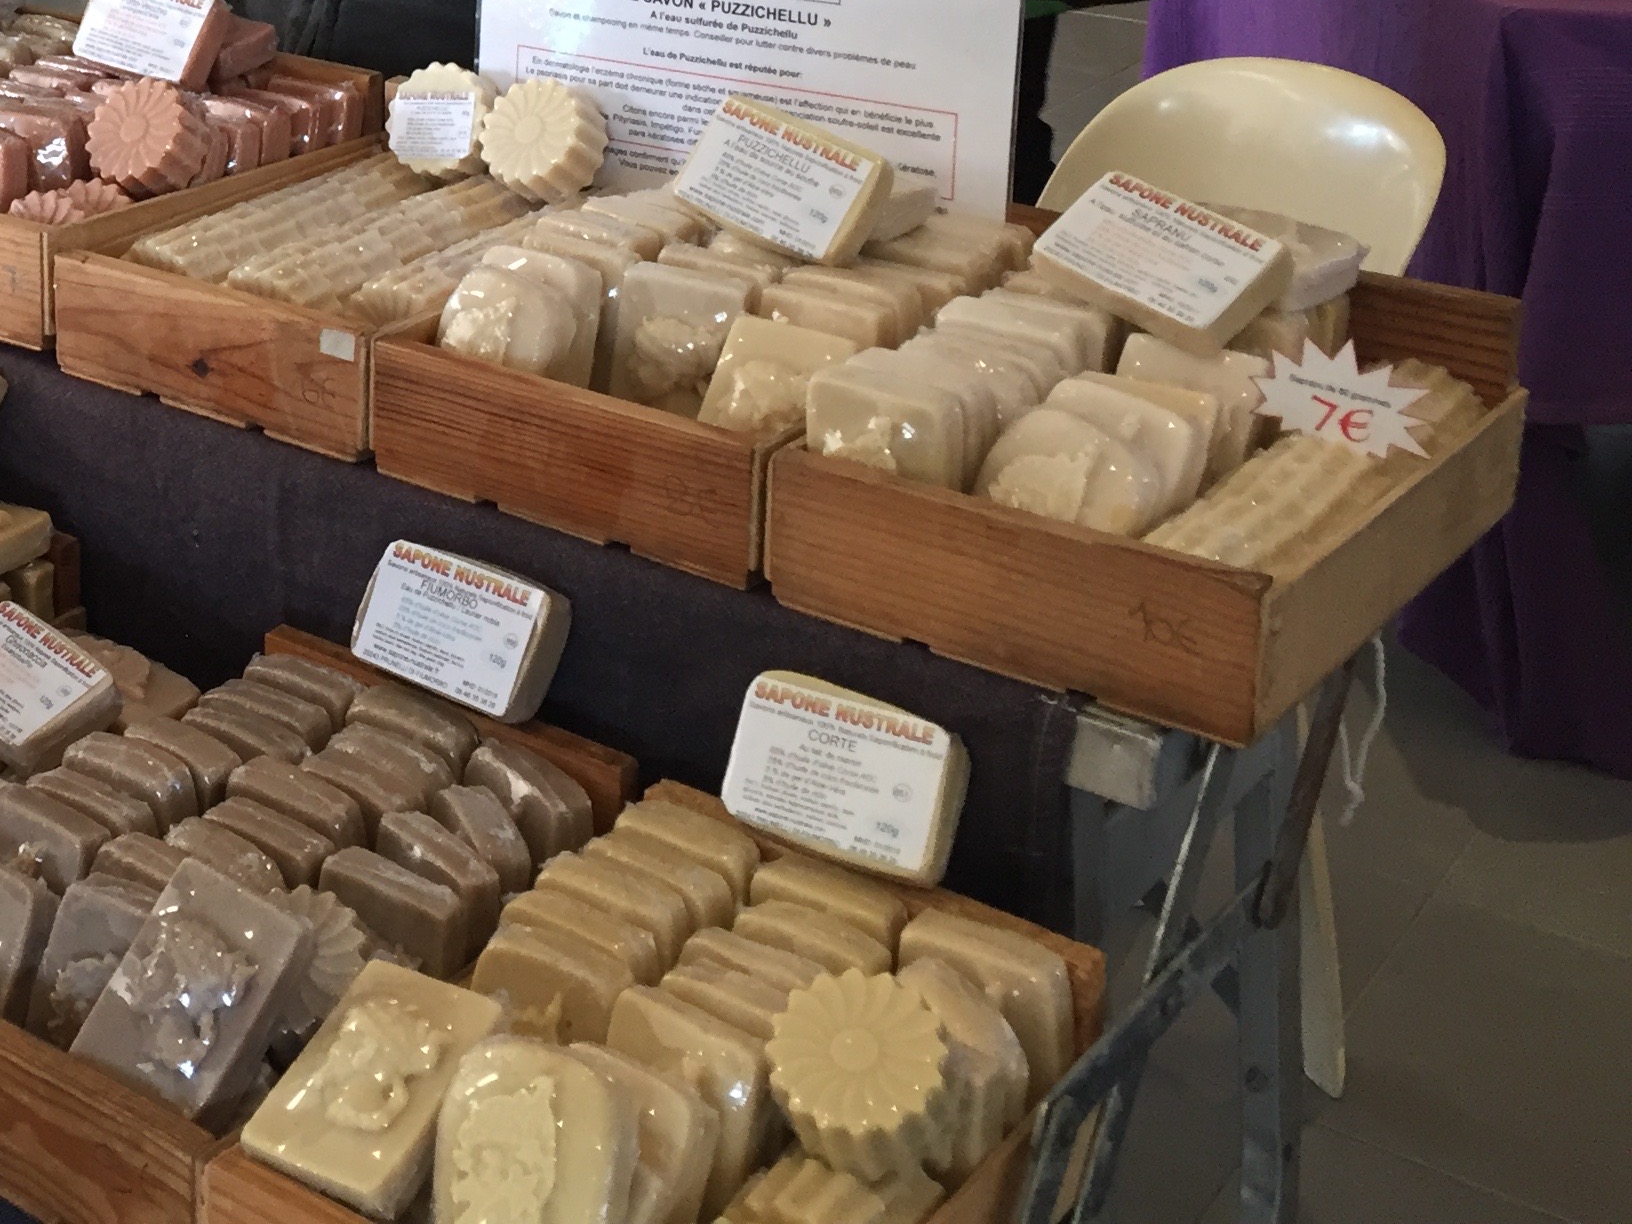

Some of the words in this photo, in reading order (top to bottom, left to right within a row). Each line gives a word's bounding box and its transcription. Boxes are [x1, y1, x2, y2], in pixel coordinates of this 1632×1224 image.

[650, 10, 658, 20] A
[659, 11, 682, 23] l'eau
[685, 14, 724, 29] sulfurée
[726, 19, 739, 31] de
[741, 22, 798, 40] Puzzichellu
[711, 0, 818, 26] PUZZICHELLU
[667, 50, 678, 60] de
[679, 52, 727, 68] Puzzichellu
[728, 61, 743, 70] est
[735, 36, 754, 47] pour
[722, 98, 781, 137] SAPONE
[781, 122, 863, 172] NUSTRALE
[737, 134, 811, 174] PUZZICHELLU
[1108, 173, 1173, 210] SAPONE
[1173, 202, 1267, 253] NUSTRALE
[1311, 394, 1374, 443] 7€
[392, 541, 453, 578] SAPONE
[453, 564, 532, 607] NUSTRALE
[420, 578, 479, 610] FIUMORBO
[39, 631, 98, 679] NUSTRALE
[754, 680, 833, 718] SAPONE
[834, 702, 936, 746] NUSTRALE
[807, 728, 859, 754] CORTE
